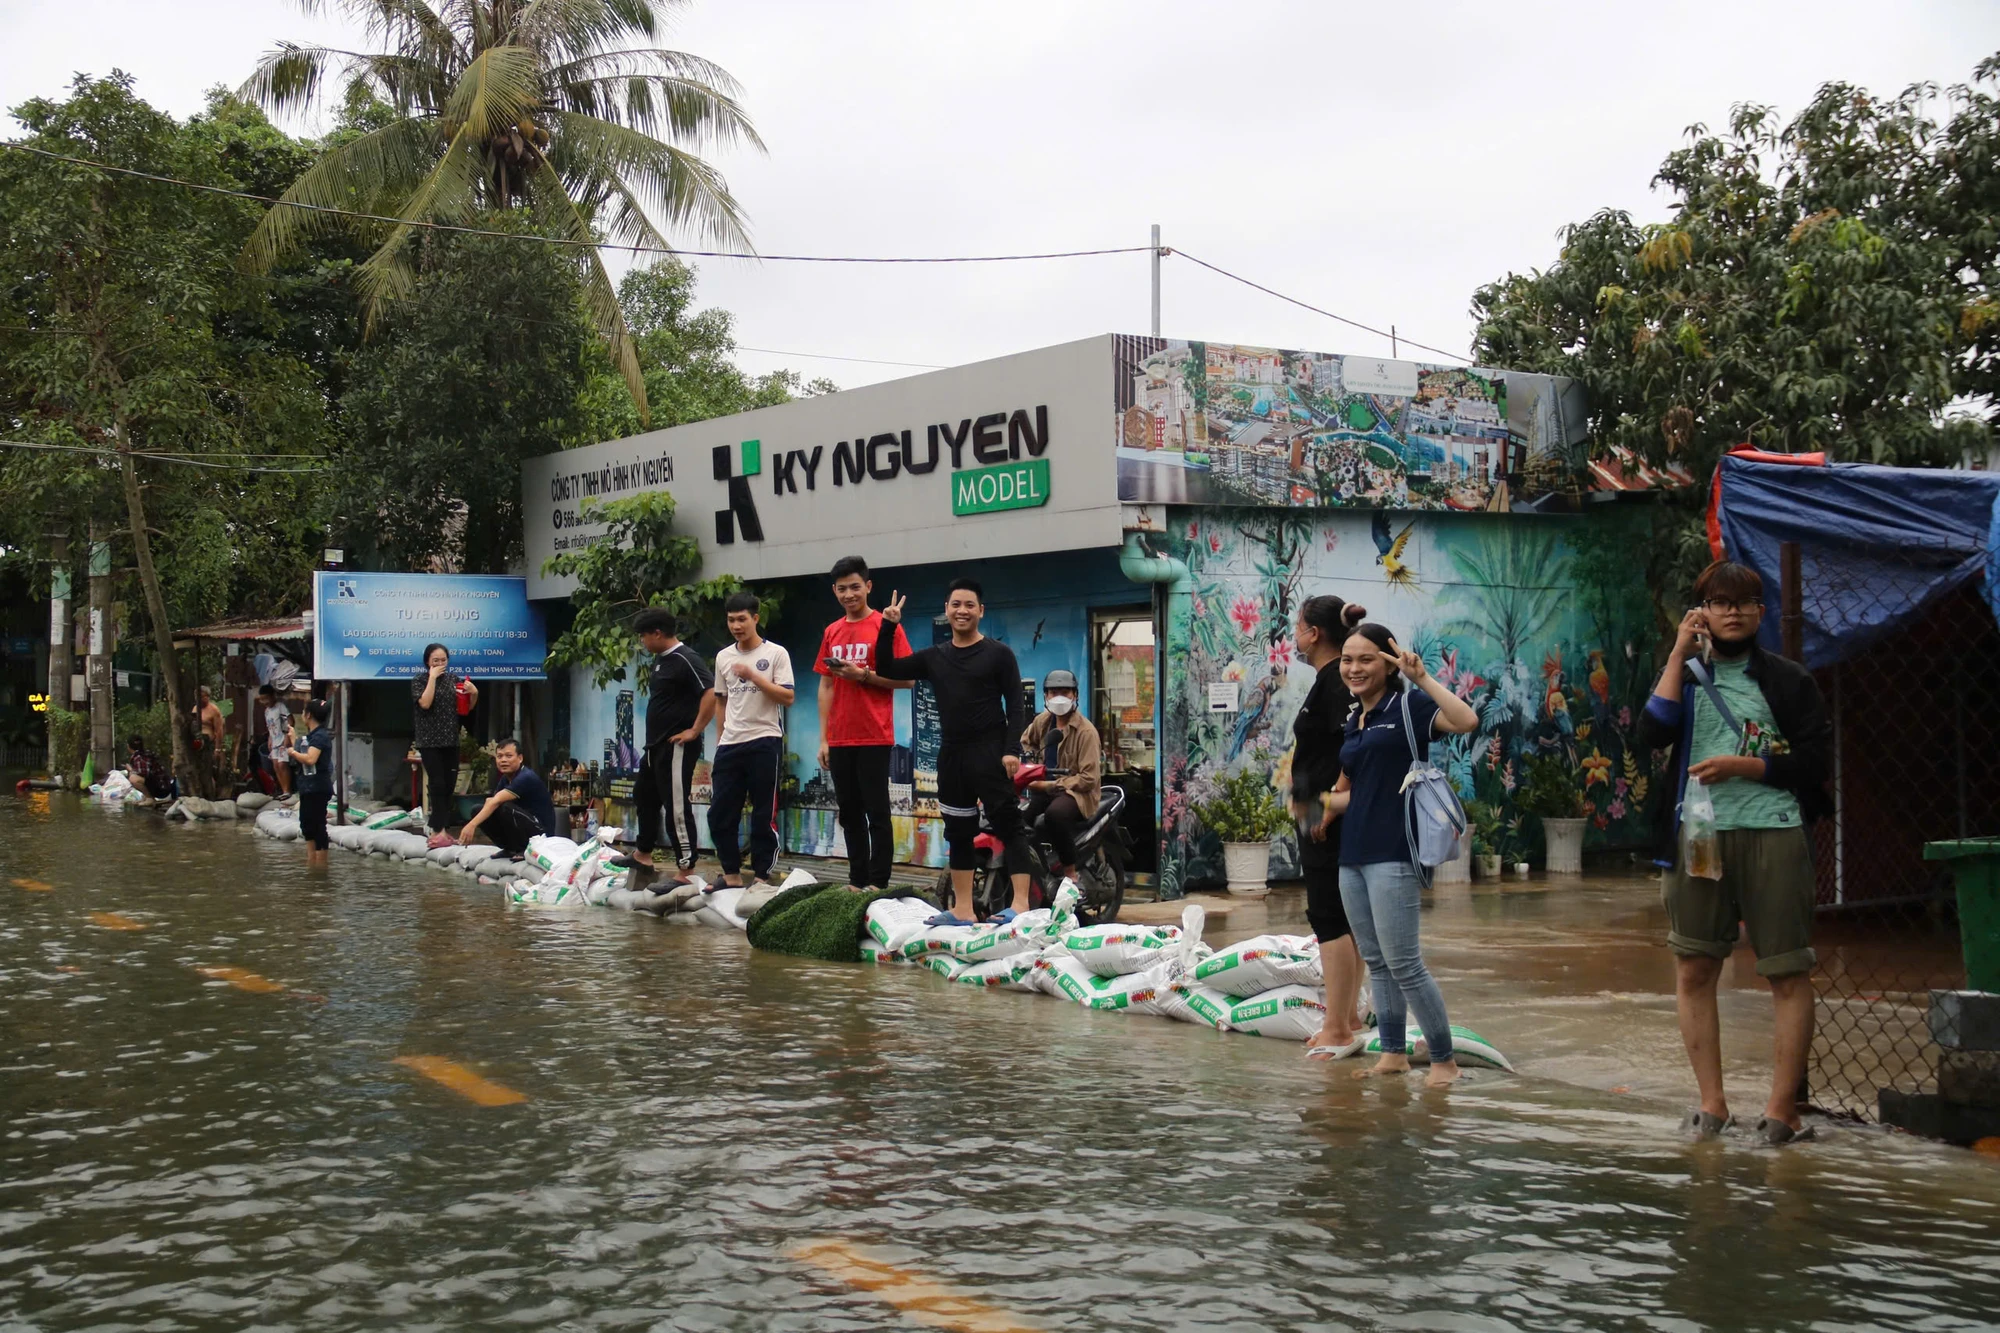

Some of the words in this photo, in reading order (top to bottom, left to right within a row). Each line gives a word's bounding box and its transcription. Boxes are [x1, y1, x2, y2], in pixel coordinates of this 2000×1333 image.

[773, 446, 823, 495] KY
[832, 405, 1048, 486] NGUYEN
[551, 472, 570, 502] CÔNG
[570, 475, 581, 499] TY
[581, 471, 599, 497] TNHH
[600, 463, 611, 493] MÔ
[612, 460, 629, 491] HÌNH
[643, 450, 673, 486] NGUYÊN
[957, 469, 1040, 507] MODEL
[563, 510, 574, 528] 566
[554, 536, 570, 551] Email:
[343, 630, 360, 638] LAO
[506, 631, 528, 639] 18-30
